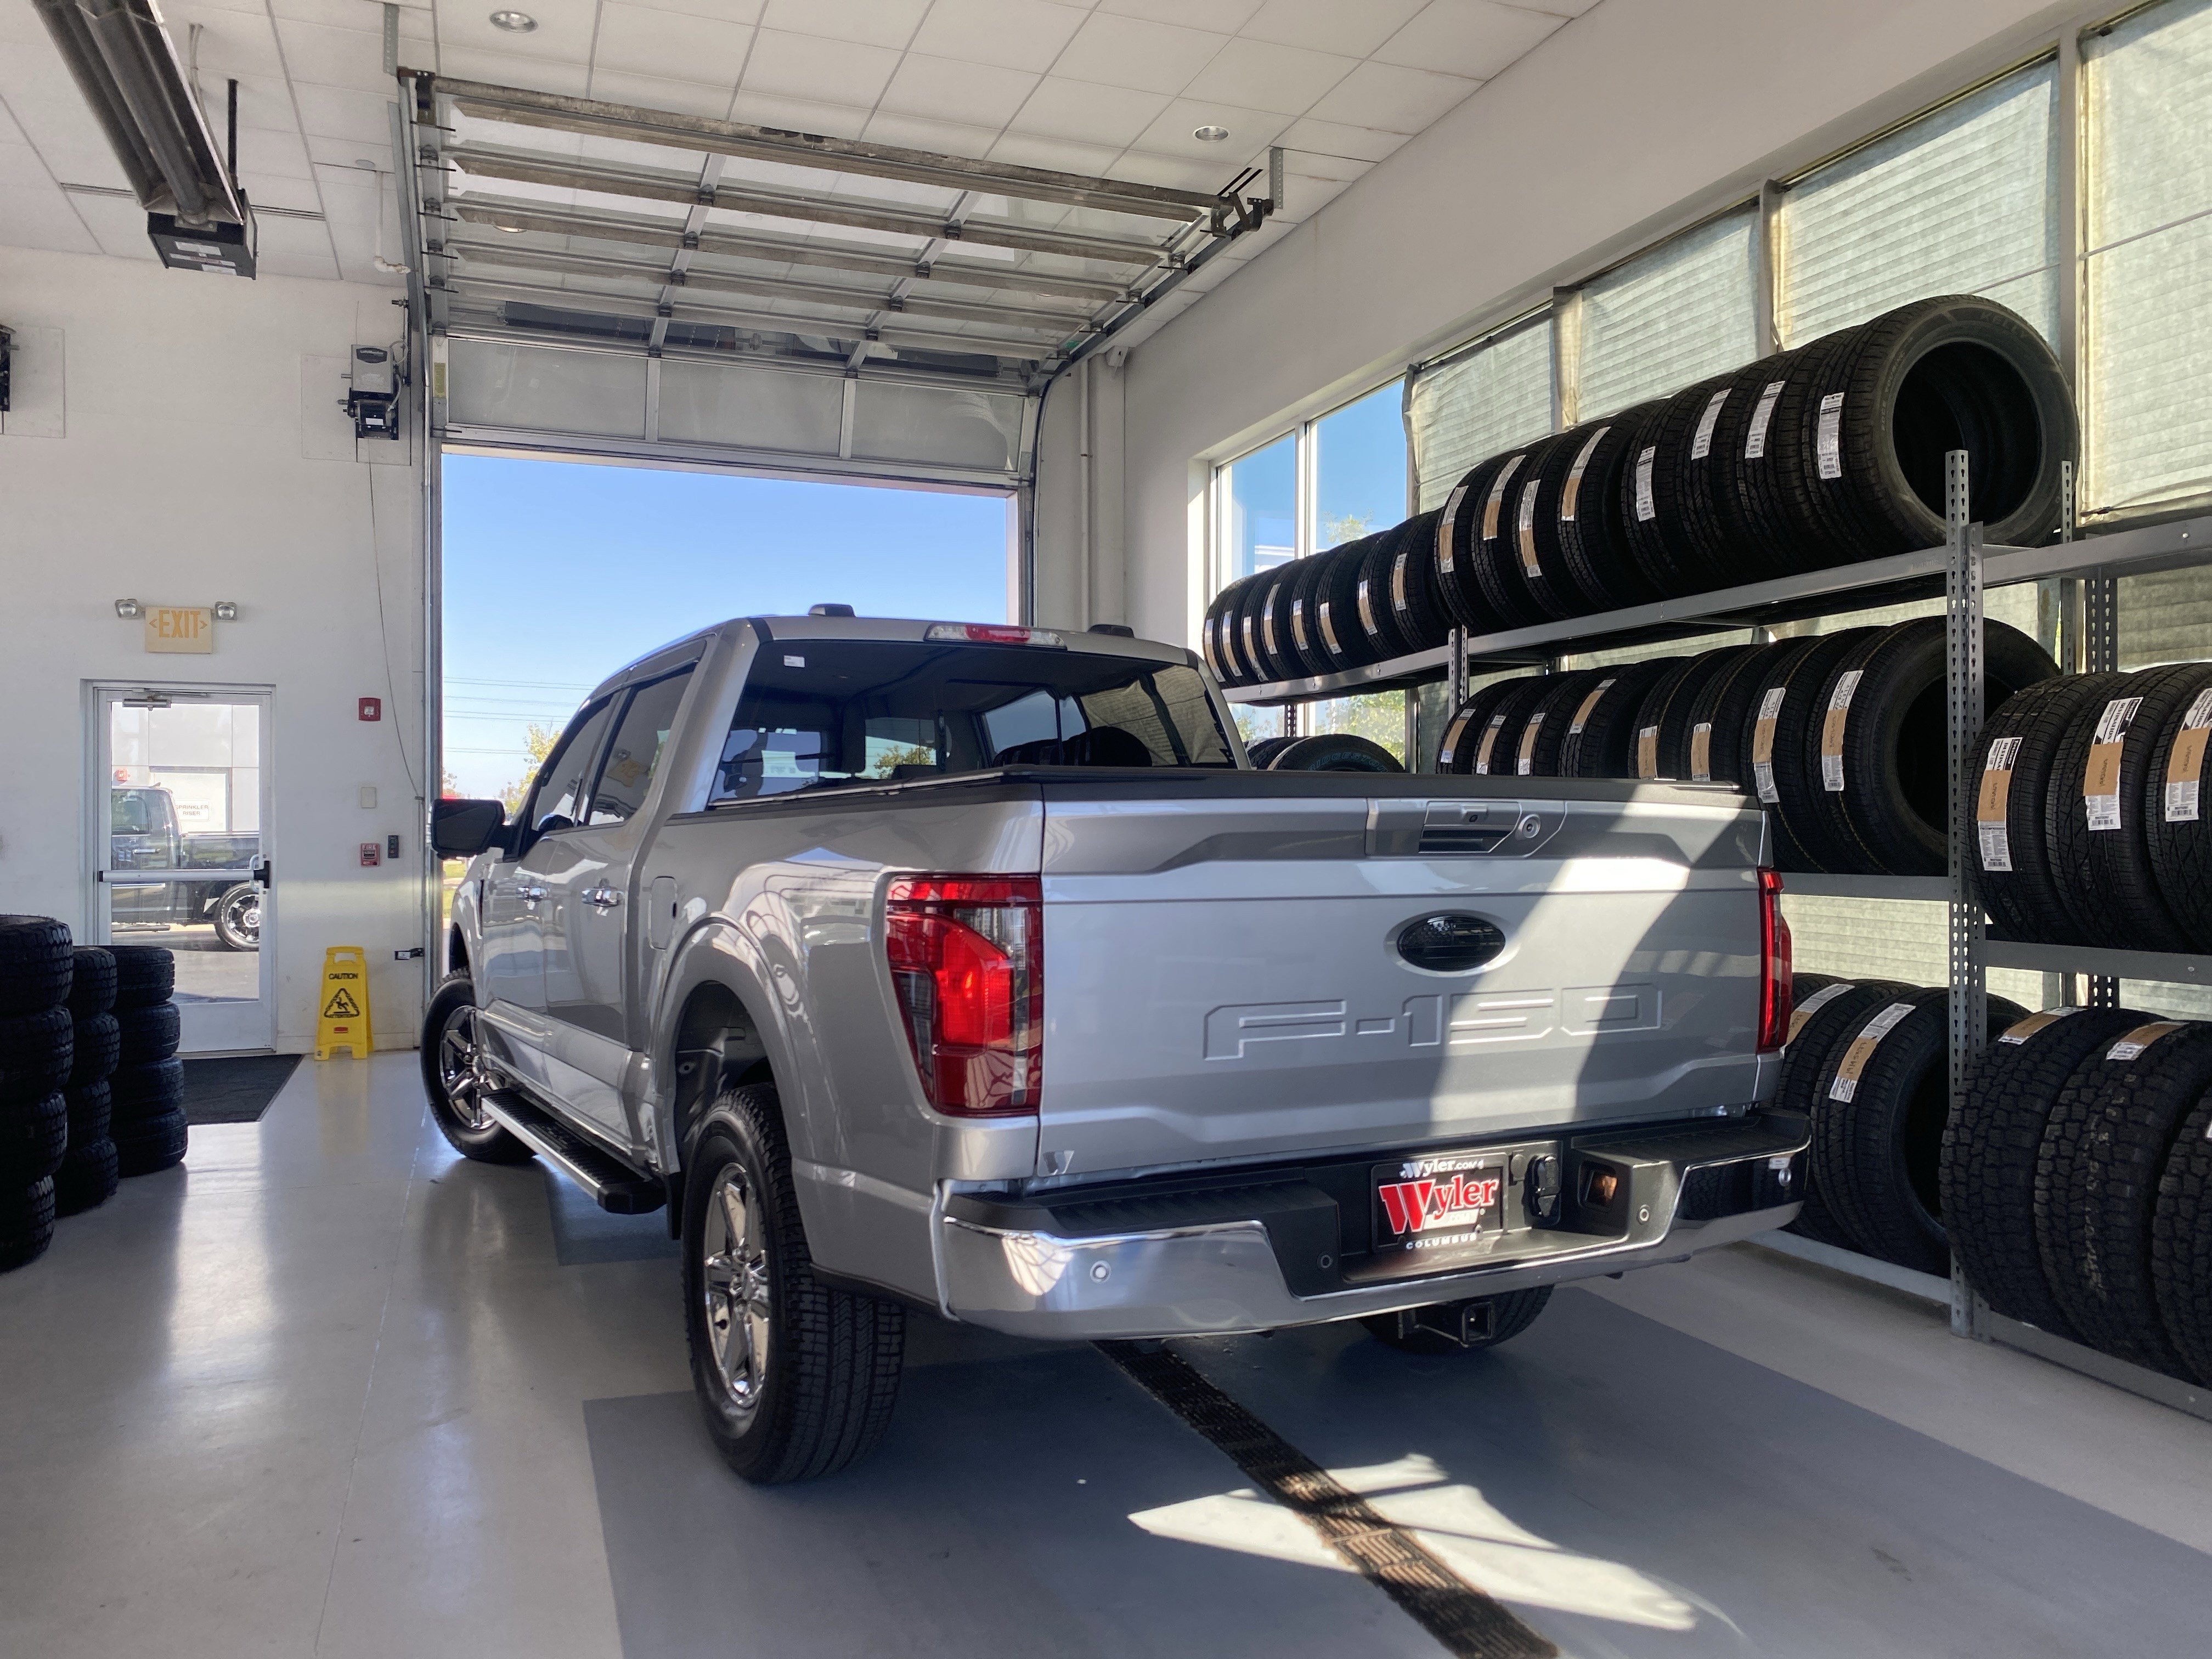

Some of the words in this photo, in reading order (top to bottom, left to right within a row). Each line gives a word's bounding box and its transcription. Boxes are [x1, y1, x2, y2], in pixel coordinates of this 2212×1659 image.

[159, 610, 201, 638] EXIT
[1204, 983, 1663, 1060] F-150
[1379, 1174, 1500, 1234] Wyler
[1406, 1233, 1477, 1250] COLUMBUS
